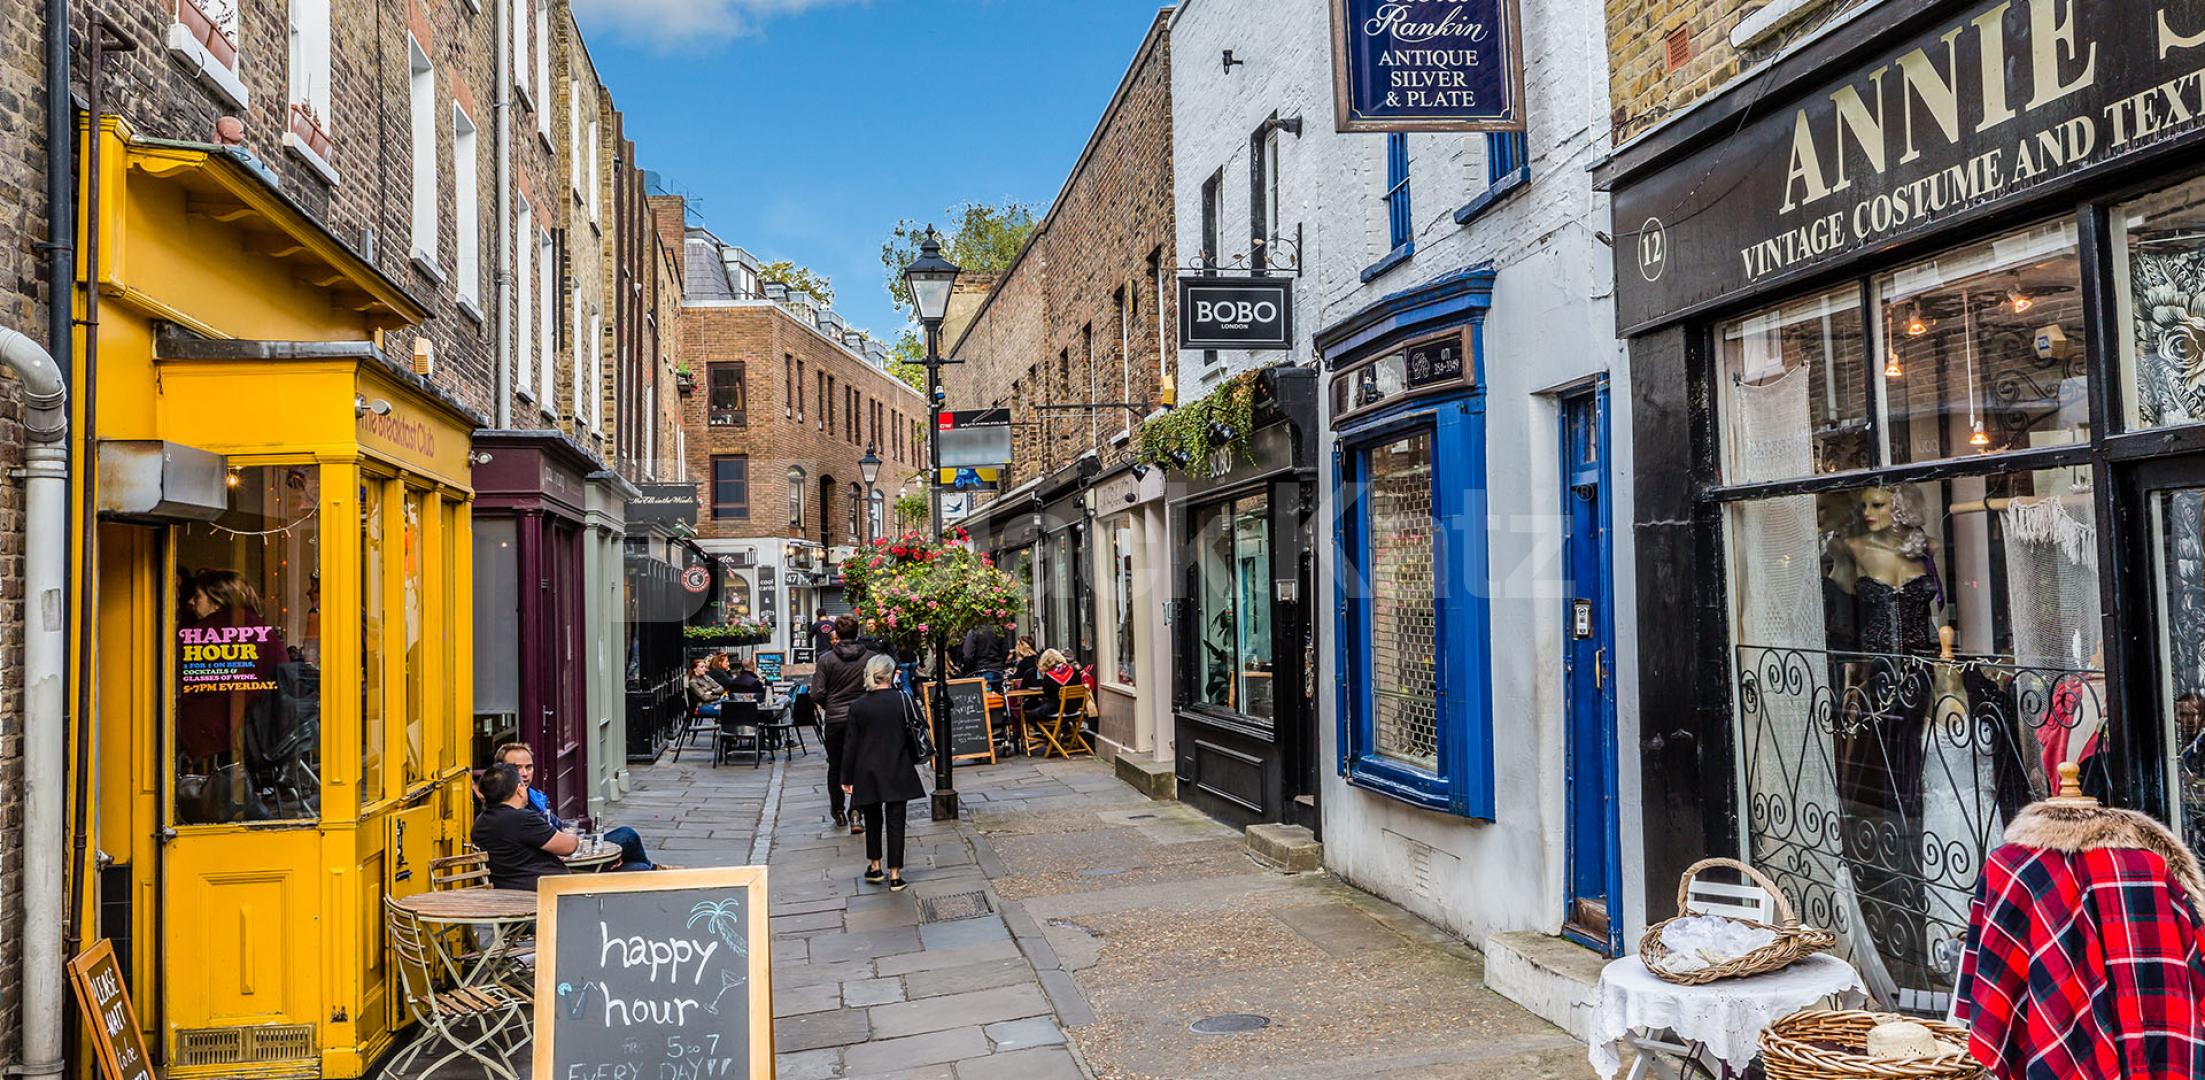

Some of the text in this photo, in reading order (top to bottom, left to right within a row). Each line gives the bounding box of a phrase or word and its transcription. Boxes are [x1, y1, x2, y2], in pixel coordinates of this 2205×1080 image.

[1364, 3, 1488, 43] Rankin
[1378, 50, 1479, 69] ANTIQUE
[1391, 71, 1468, 87] SILVER
[1385, 91, 1476, 107] & PLATE
[1778, 0, 2097, 214] ANNIE
[1741, 211, 1846, 282] VINTAGE
[1852, 150, 2004, 242] COSTUME
[2011, 115, 2096, 184] AND
[1642, 230, 1662, 266] 12
[1196, 300, 1277, 323] BOBO
[416, 421, 435, 458] Club
[759, 578, 774, 586] cool
[786, 574, 797, 583] 47
[179, 626, 272, 644] HAPPY
[183, 644, 259, 661] HOUR
[183, 681, 279, 693] 5-7PM EVERDAY.
[600, 921, 718, 984] happy
[600, 981, 699, 1027] hour
[667, 1035, 683, 1058] 5
[706, 1033, 720, 1055] 7
